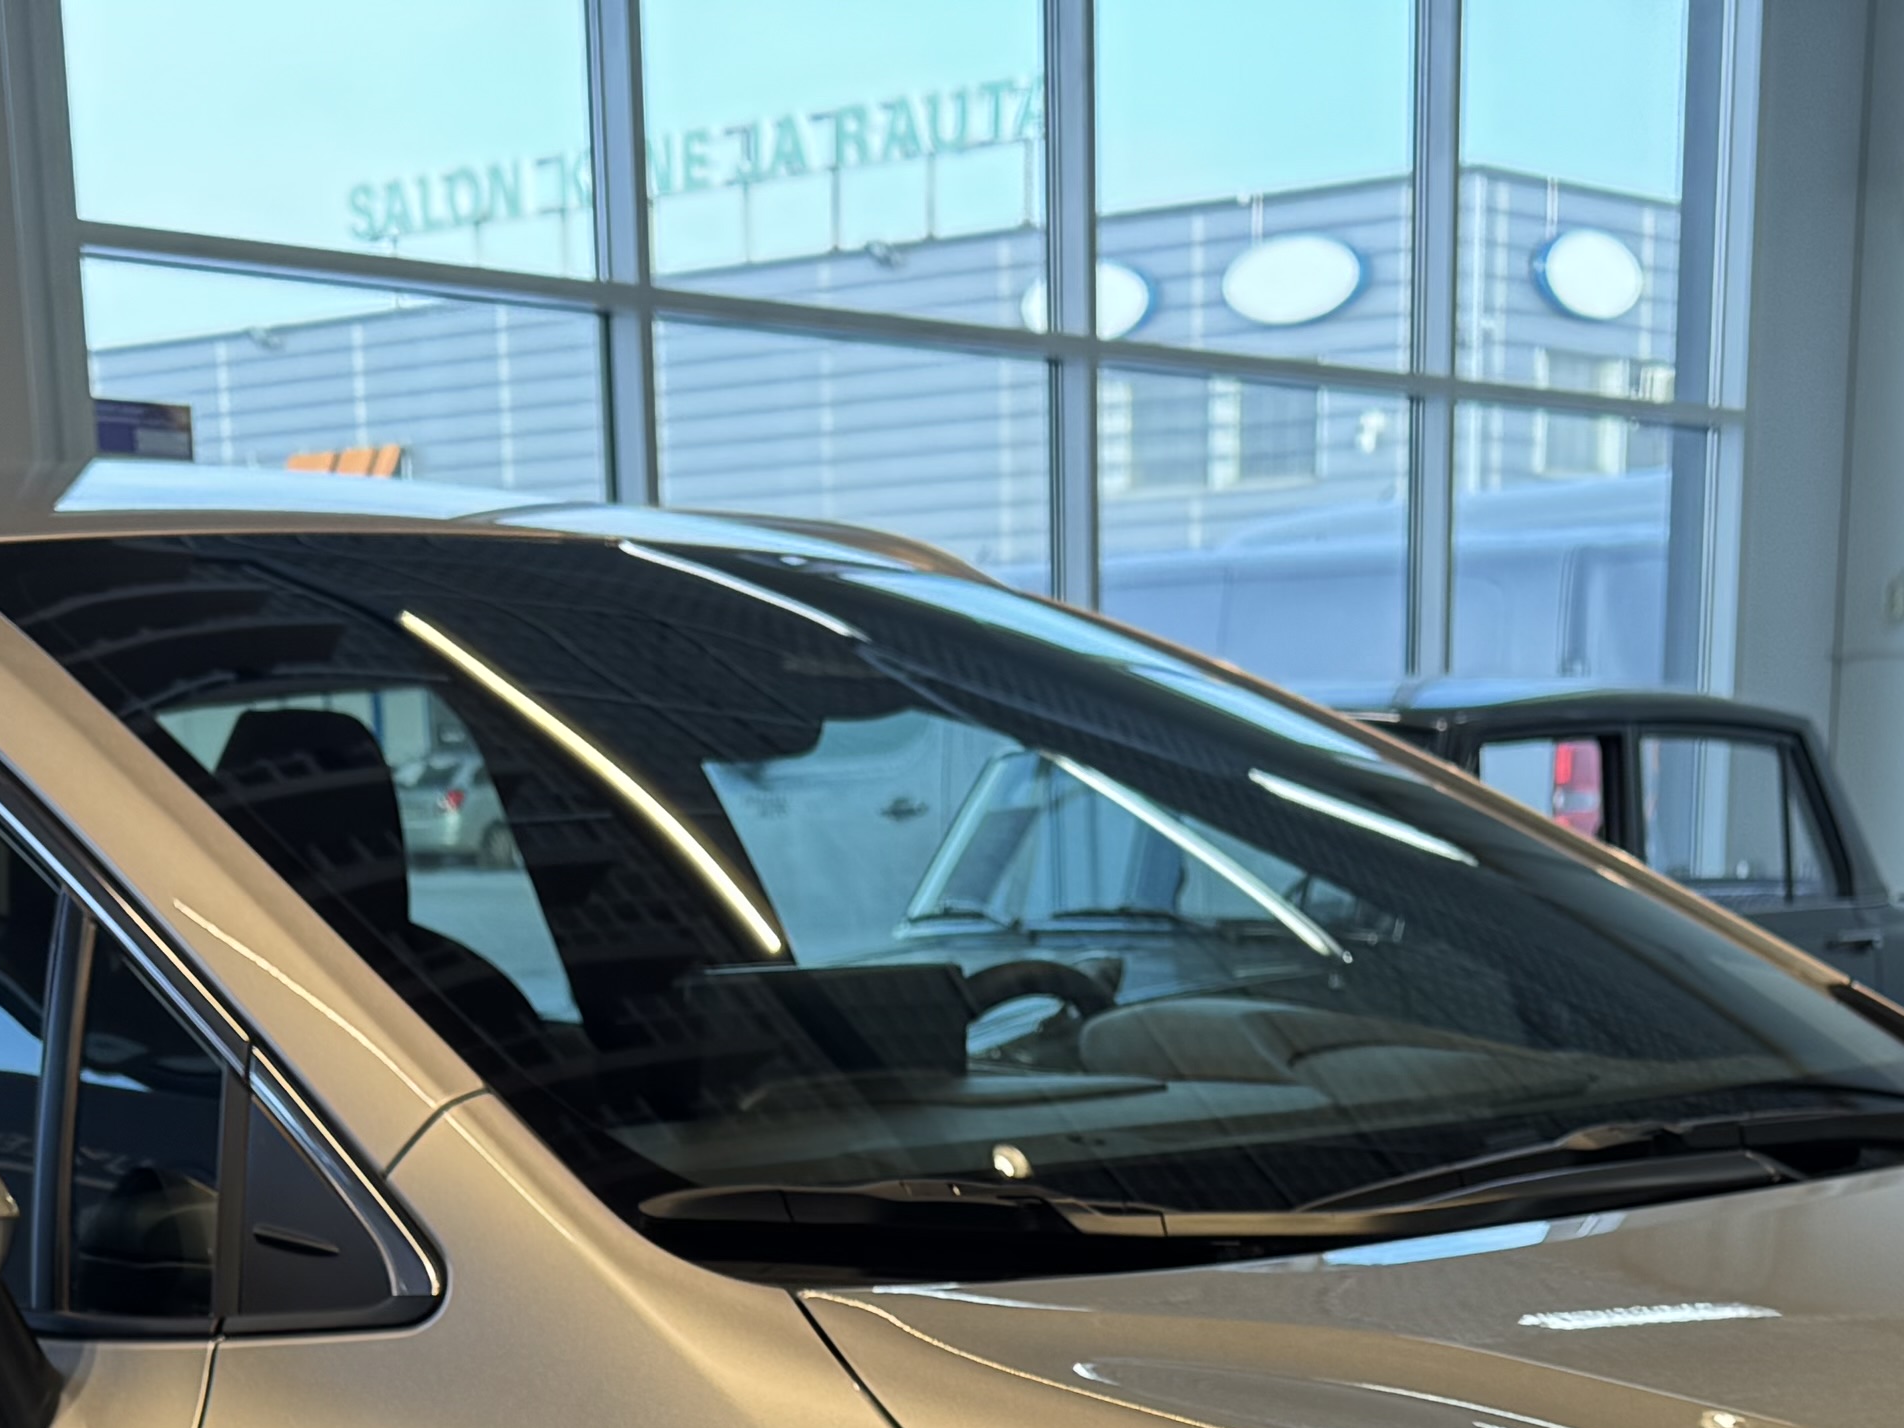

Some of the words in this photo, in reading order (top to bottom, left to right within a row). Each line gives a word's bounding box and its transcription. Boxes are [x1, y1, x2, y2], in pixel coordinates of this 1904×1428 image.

[348, 158, 520, 241] SALON
[555, 128, 714, 208] KNE
[733, 113, 811, 184] JA
